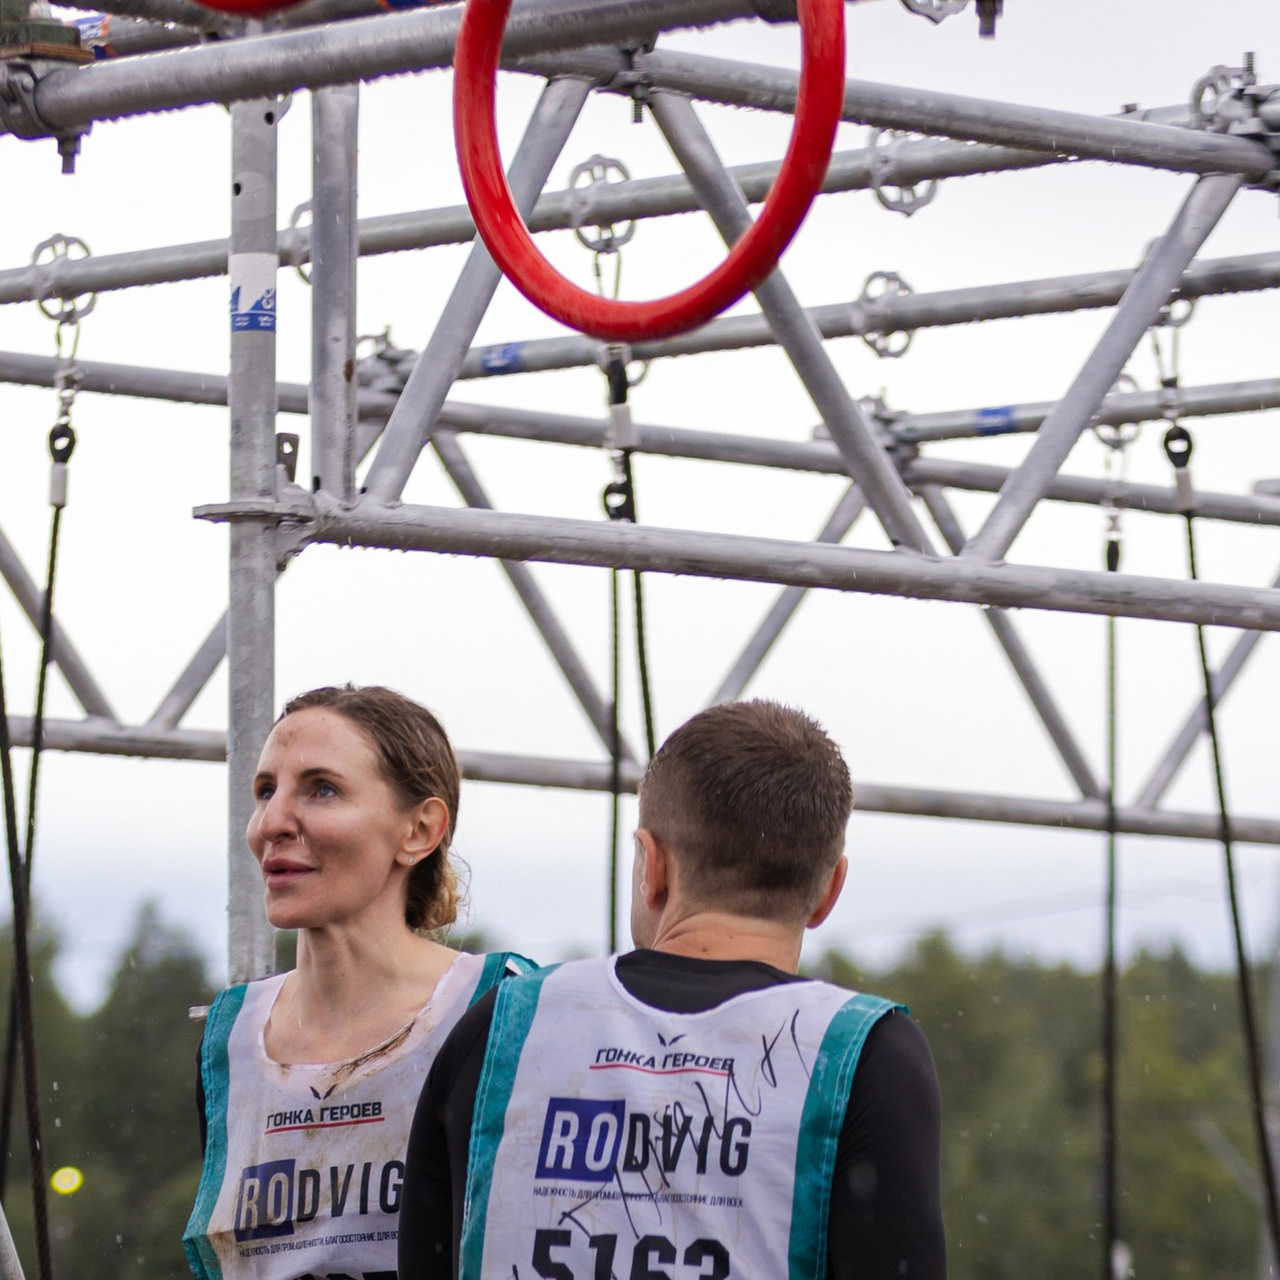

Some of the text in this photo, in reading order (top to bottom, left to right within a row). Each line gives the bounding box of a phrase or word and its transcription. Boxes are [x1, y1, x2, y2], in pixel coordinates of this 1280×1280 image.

[595, 1048, 735, 1071] ГОНКА ГЕРОЕВ
[266, 1101, 383, 1129] ГОНКА ГЕРОЕВ
[544, 1110, 752, 1177] RODVIG
[238, 1160, 405, 1233] RODVIG
